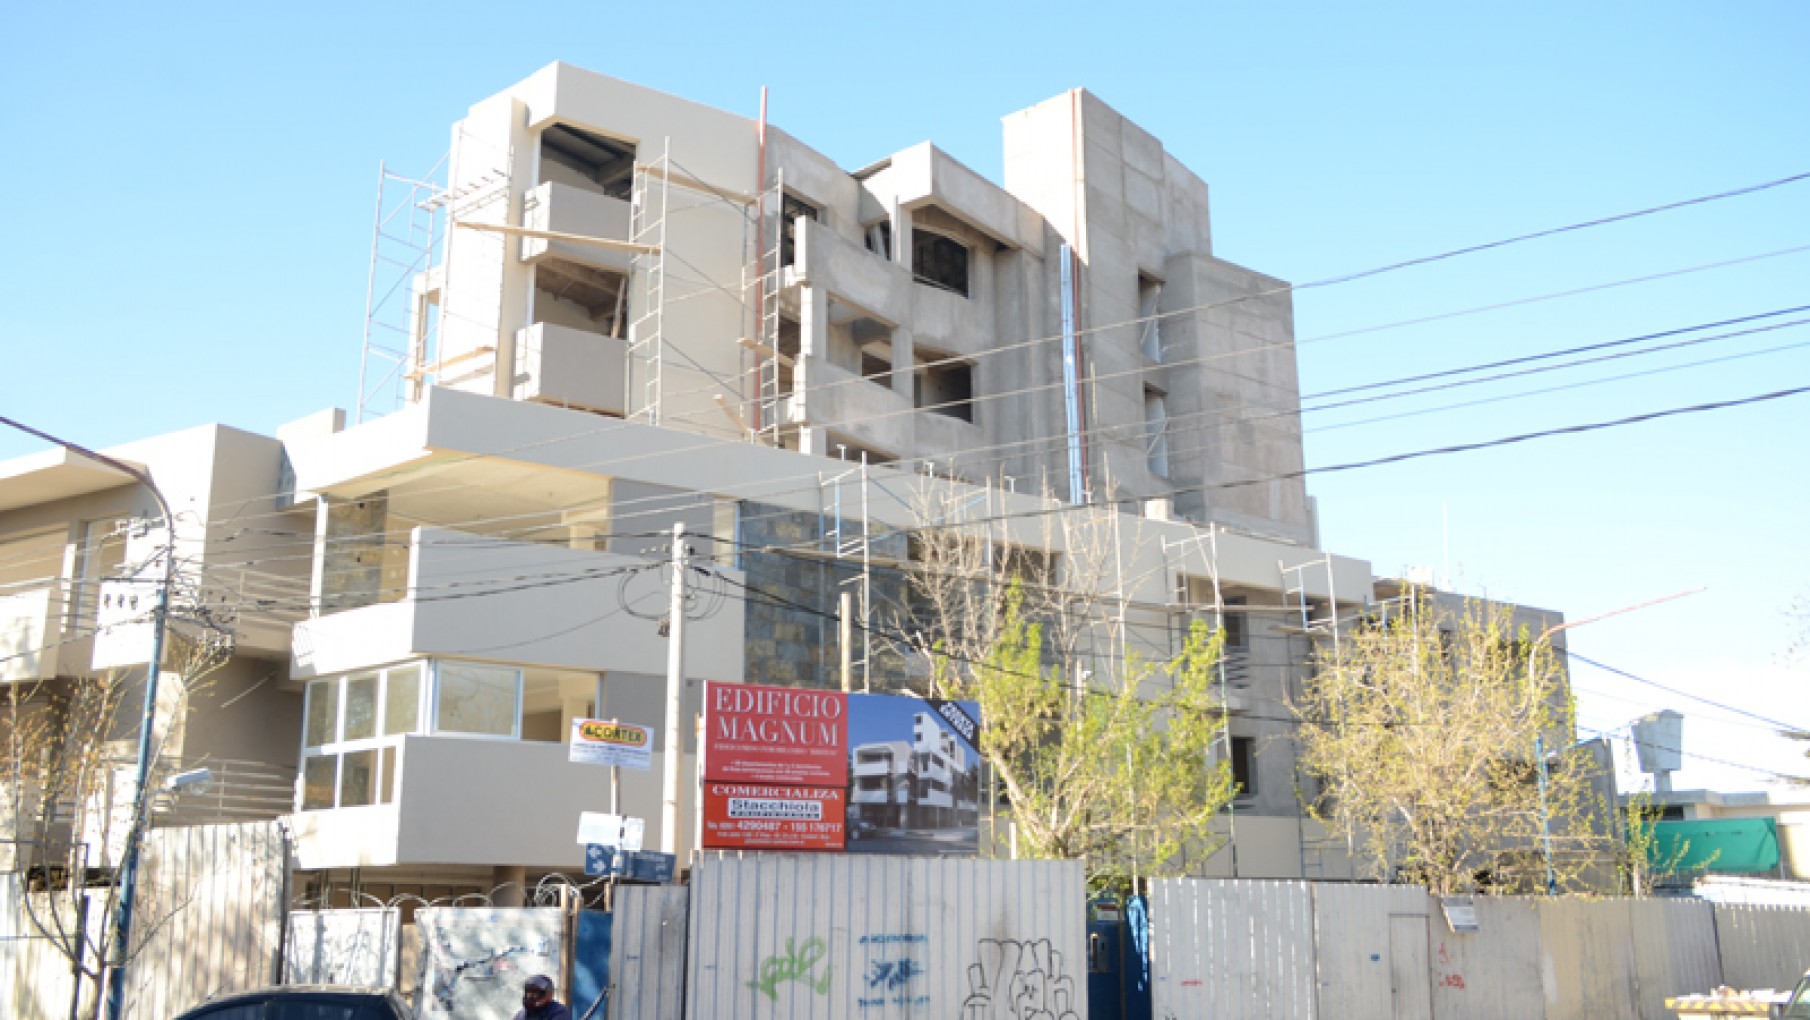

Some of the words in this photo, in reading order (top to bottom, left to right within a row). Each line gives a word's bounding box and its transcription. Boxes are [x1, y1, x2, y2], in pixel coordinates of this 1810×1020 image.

[715, 687, 842, 719] EDIFICIO
[717, 716, 839, 747] MAGNUM
[712, 785, 839, 800] COMERCIALIZA
[732, 800, 819, 812] Stacchiola
